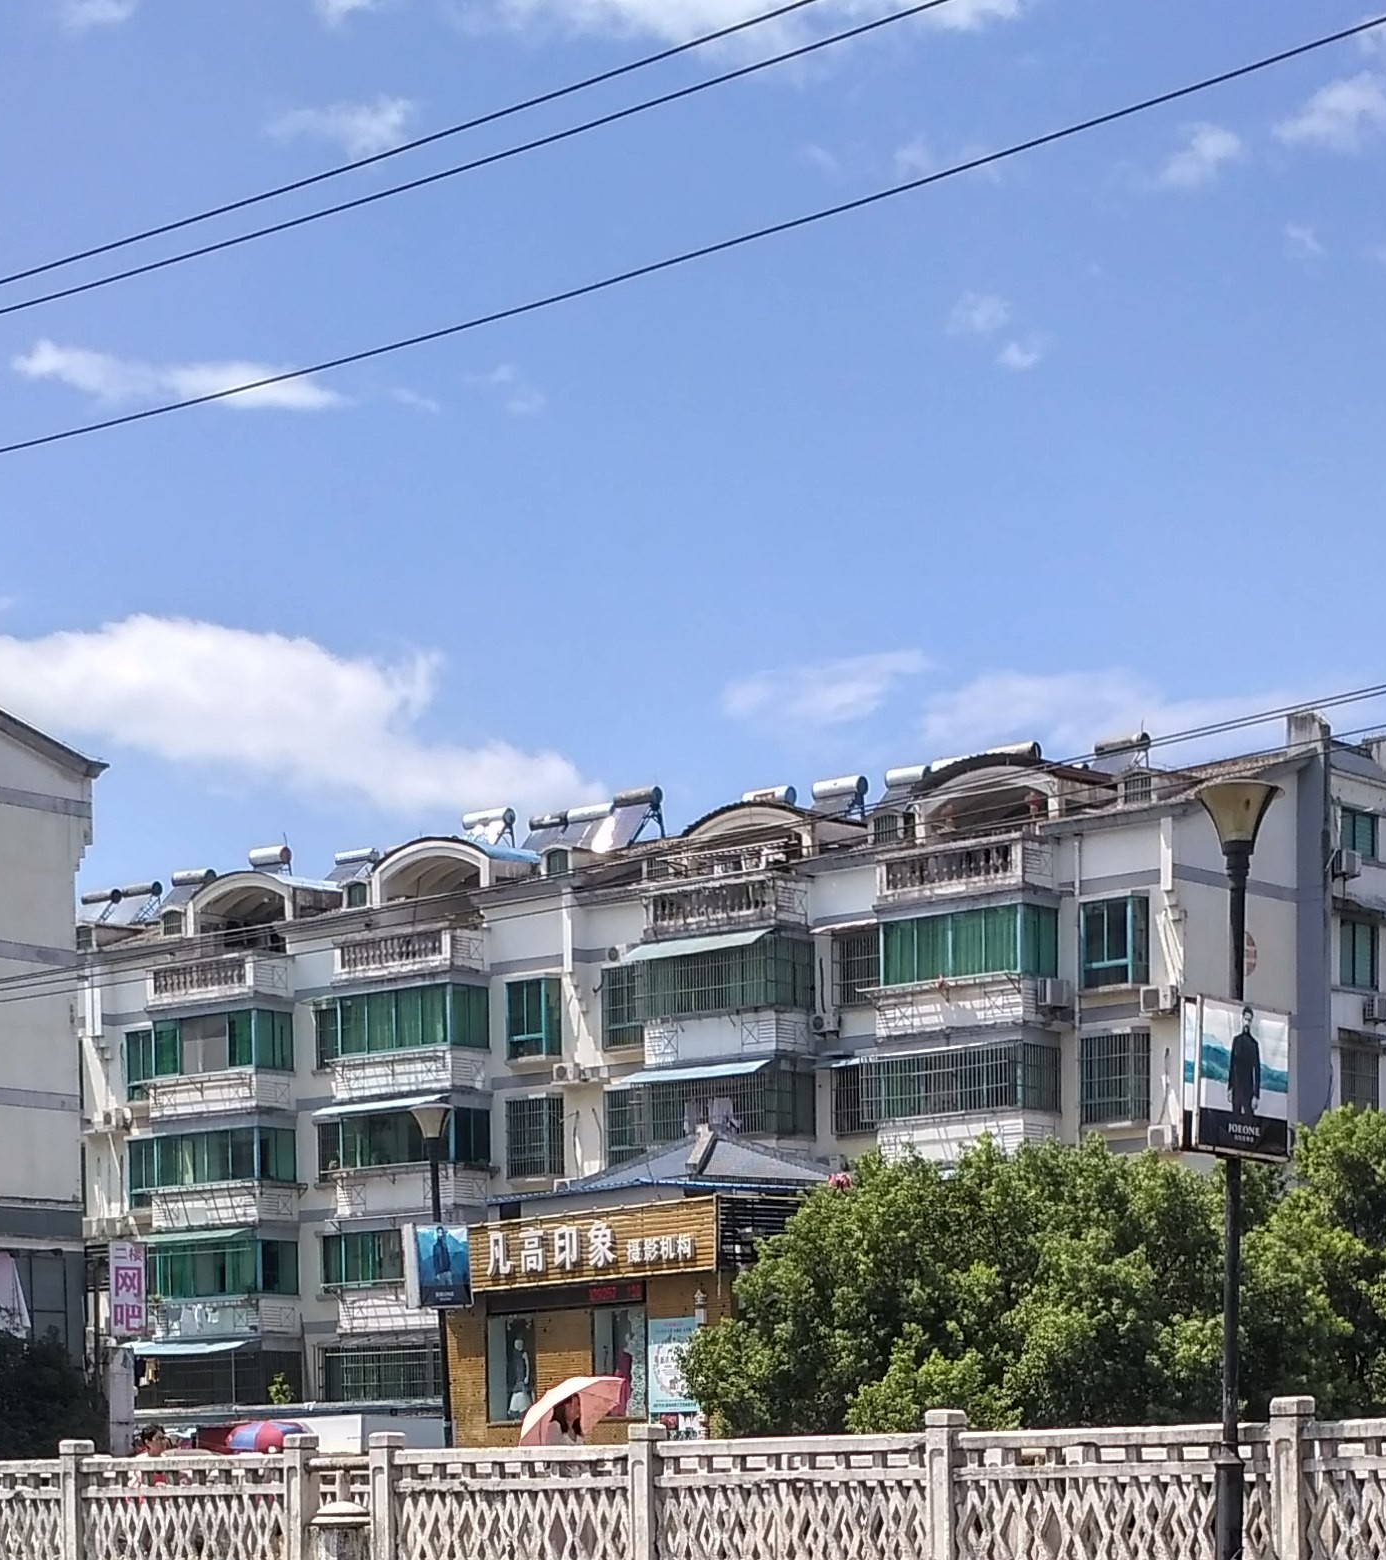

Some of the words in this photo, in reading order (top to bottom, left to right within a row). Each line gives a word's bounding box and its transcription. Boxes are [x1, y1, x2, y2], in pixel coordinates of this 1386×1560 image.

[1228, 1122, 1261, 1137] JOEONE
[486, 1220, 617, 1277] 凡高印象
[626, 1234, 697, 1265] 摄影机构
[114, 1266, 143, 1331] 网吧
